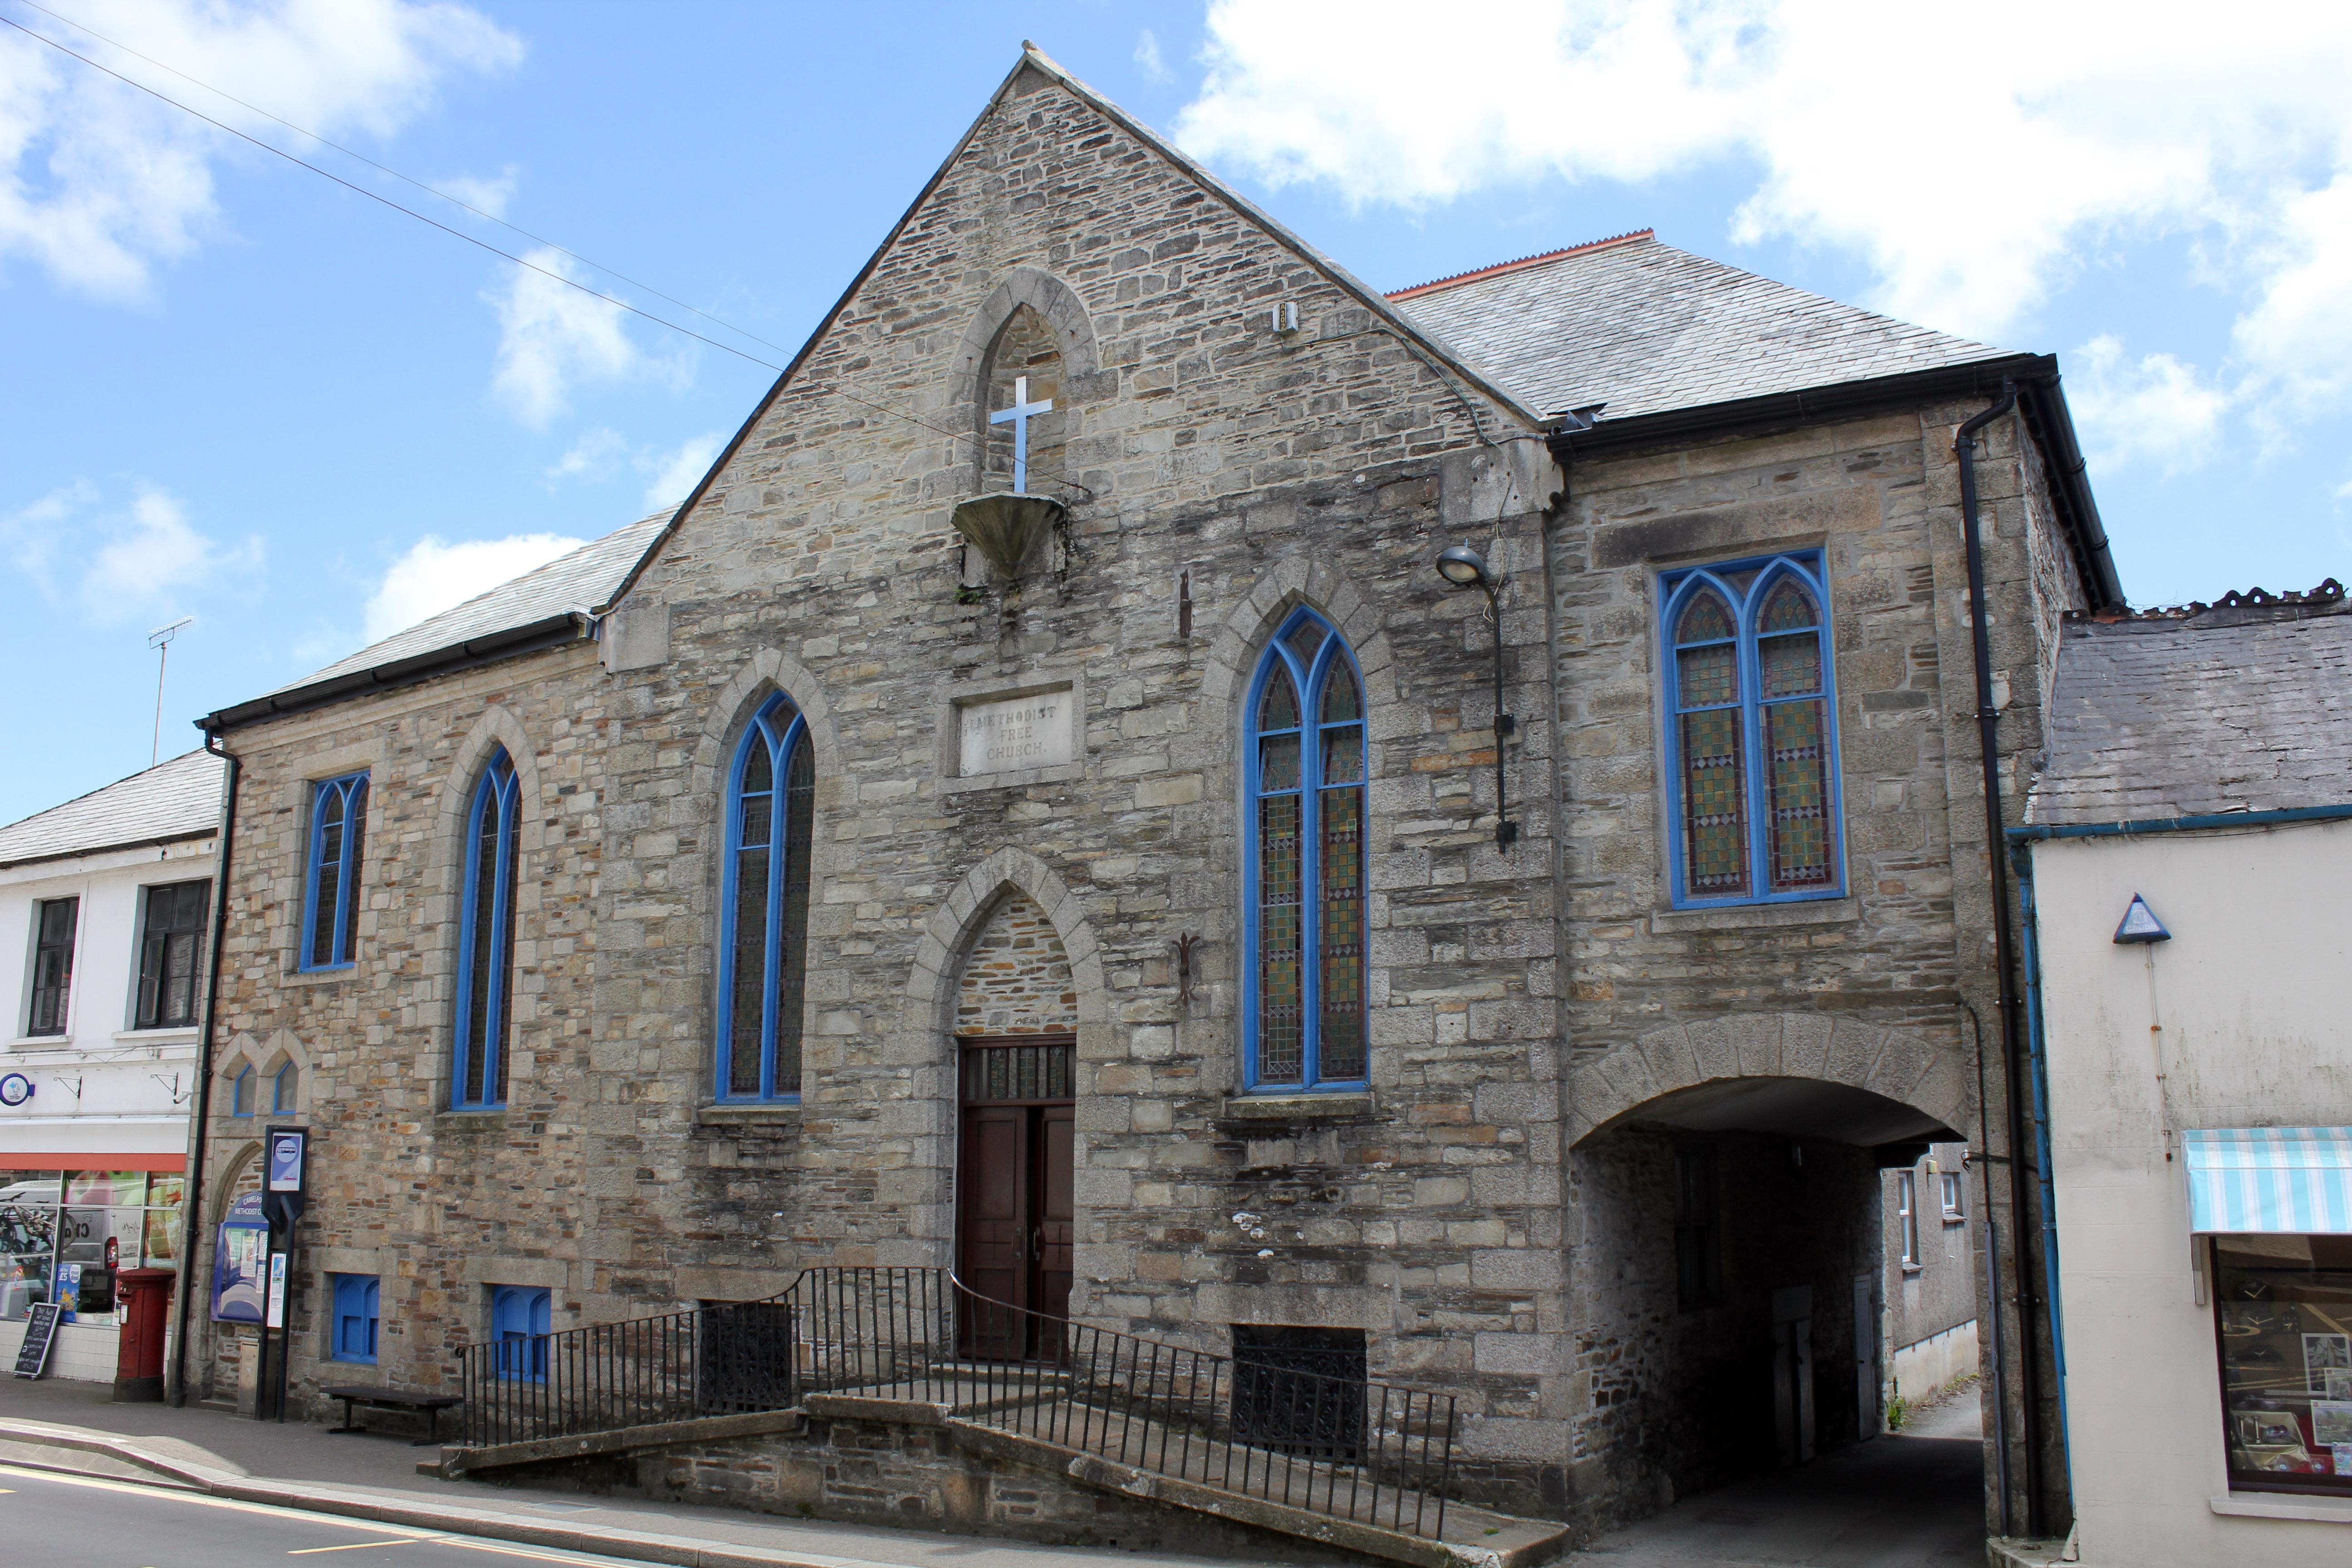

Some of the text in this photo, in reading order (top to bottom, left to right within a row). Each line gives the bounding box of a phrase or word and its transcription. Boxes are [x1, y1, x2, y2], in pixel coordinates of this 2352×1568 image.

[976, 706, 1056, 727] METHODIST
[1000, 726, 1032, 742] FREE
[243, 1196, 262, 1205] CAMELFO
[59, 1272, 68, 1281] £5
